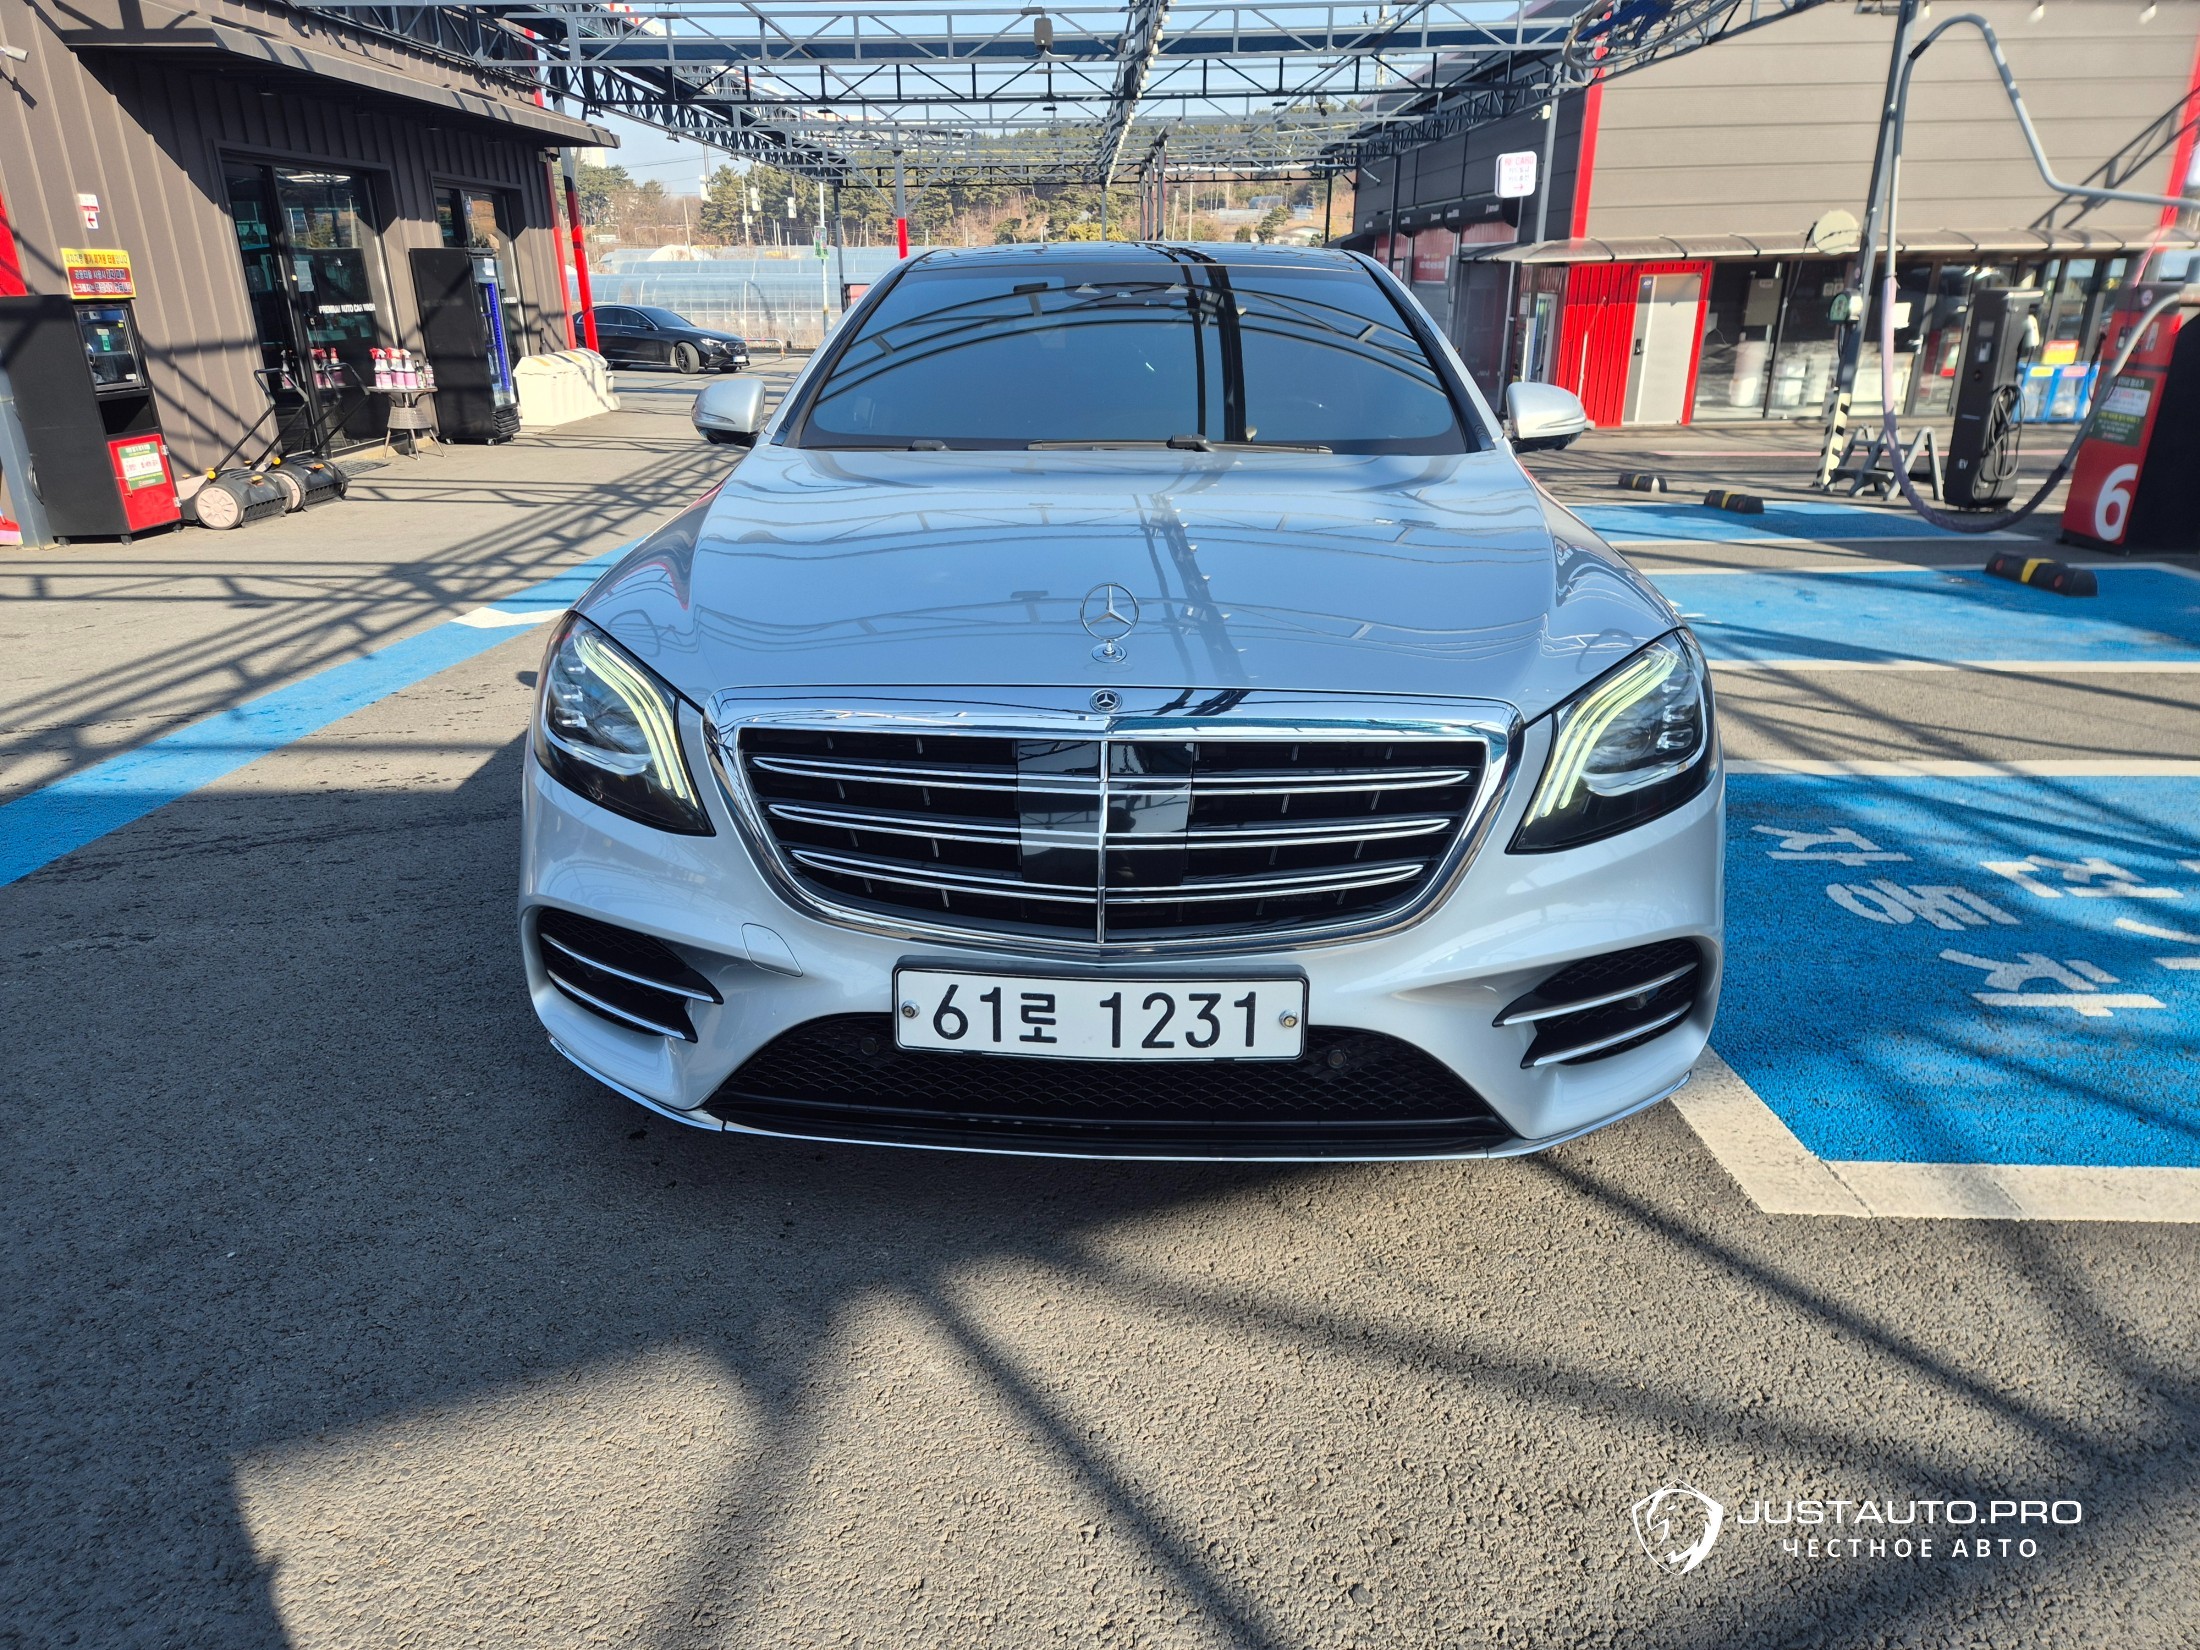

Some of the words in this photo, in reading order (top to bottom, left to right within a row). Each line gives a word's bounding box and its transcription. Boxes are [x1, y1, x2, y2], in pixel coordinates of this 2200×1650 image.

[1516, 156, 1534, 165] CARD
[319, 305, 341, 314] PREMIUM
[341, 305, 354, 313] AUTO
[354, 304, 363, 312] CAR
[363, 303, 375, 312] WASH
[1958, 458, 1968, 470] EV
[2095, 463, 2139, 542] 6
[932, 983, 1058, 1043] 61로
[1099, 991, 1257, 1049] 1231
